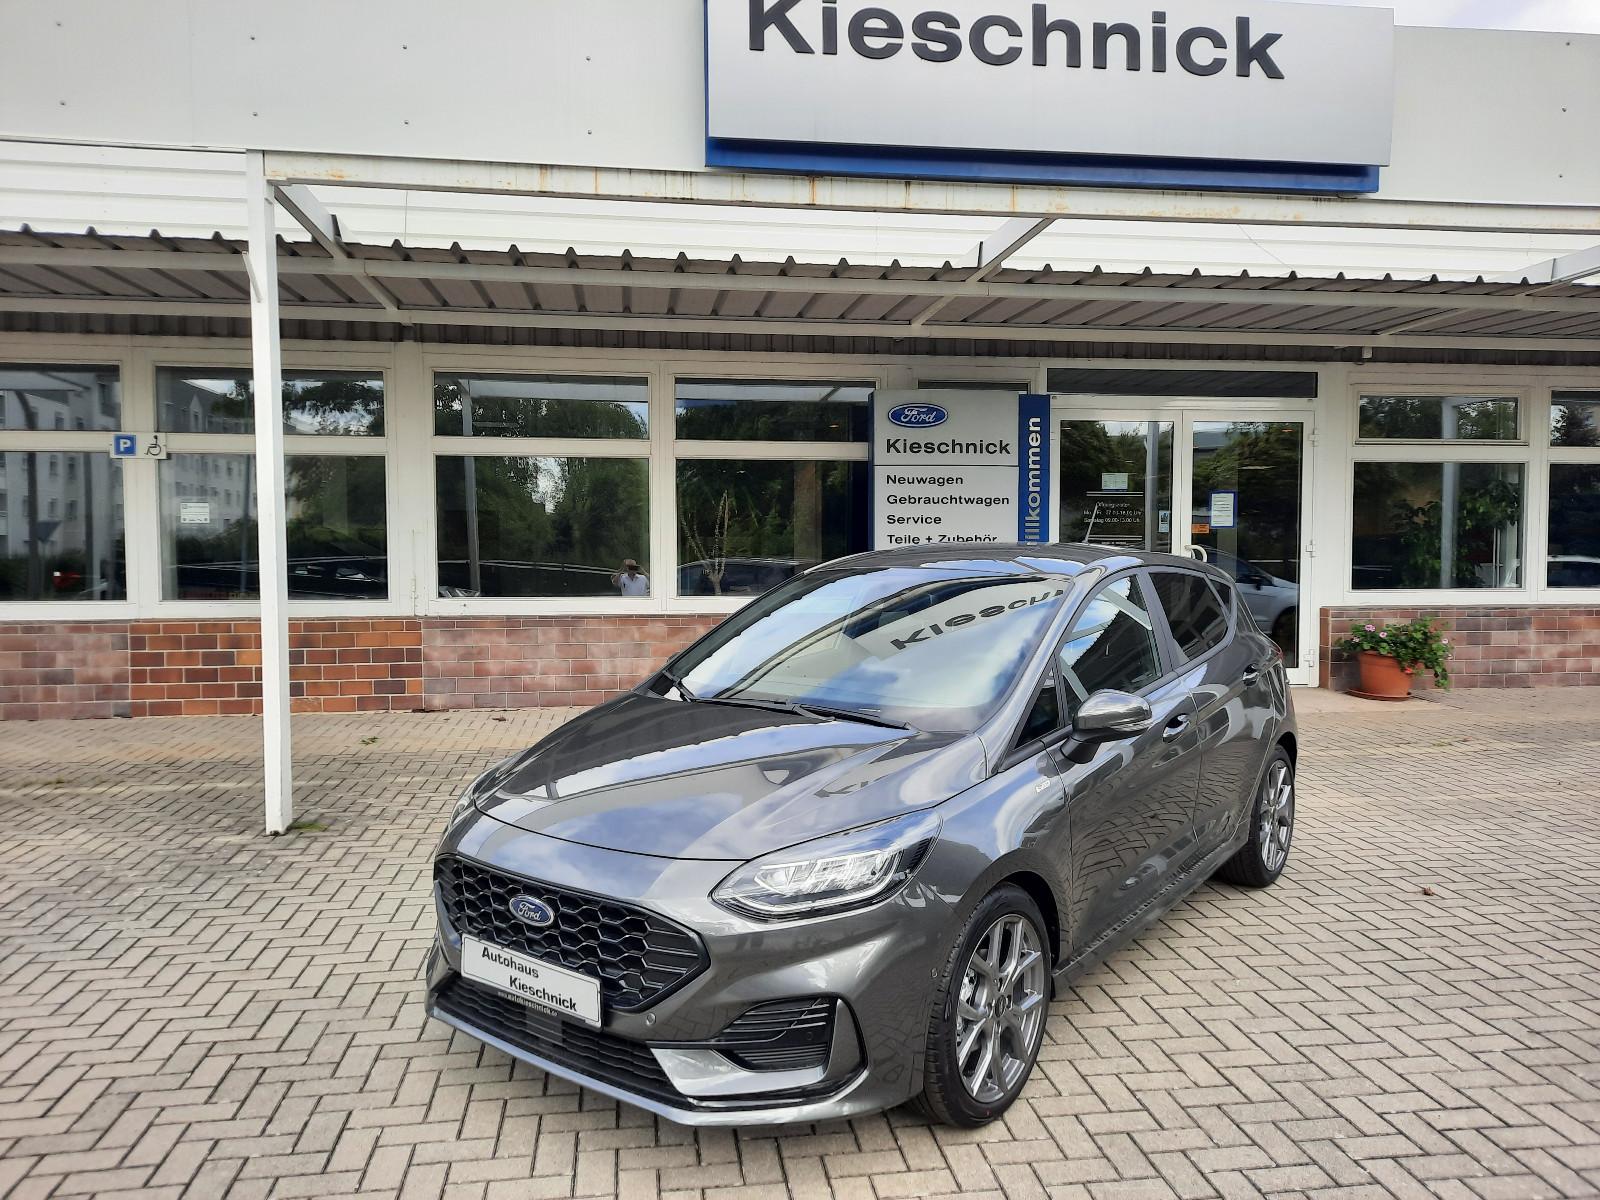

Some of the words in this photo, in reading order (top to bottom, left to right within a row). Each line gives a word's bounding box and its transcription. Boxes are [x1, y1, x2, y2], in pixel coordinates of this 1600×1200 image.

[748, 0, 1285, 79] Kieschnick
[119, 439, 131, 452] P
[886, 438, 1011, 455] Kieschnick
[886, 474, 964, 486] Neuwagen
[1024, 417, 1041, 545] illkommen
[886, 494, 1010, 506] Gebrauchtwagen
[887, 514, 943, 525] Service
[887, 534, 920, 545] Teile
[938, 534, 998, 543] Zubehör
[481, 946, 540, 979] Autohaus
[509, 975, 577, 1012] Kieschnick
